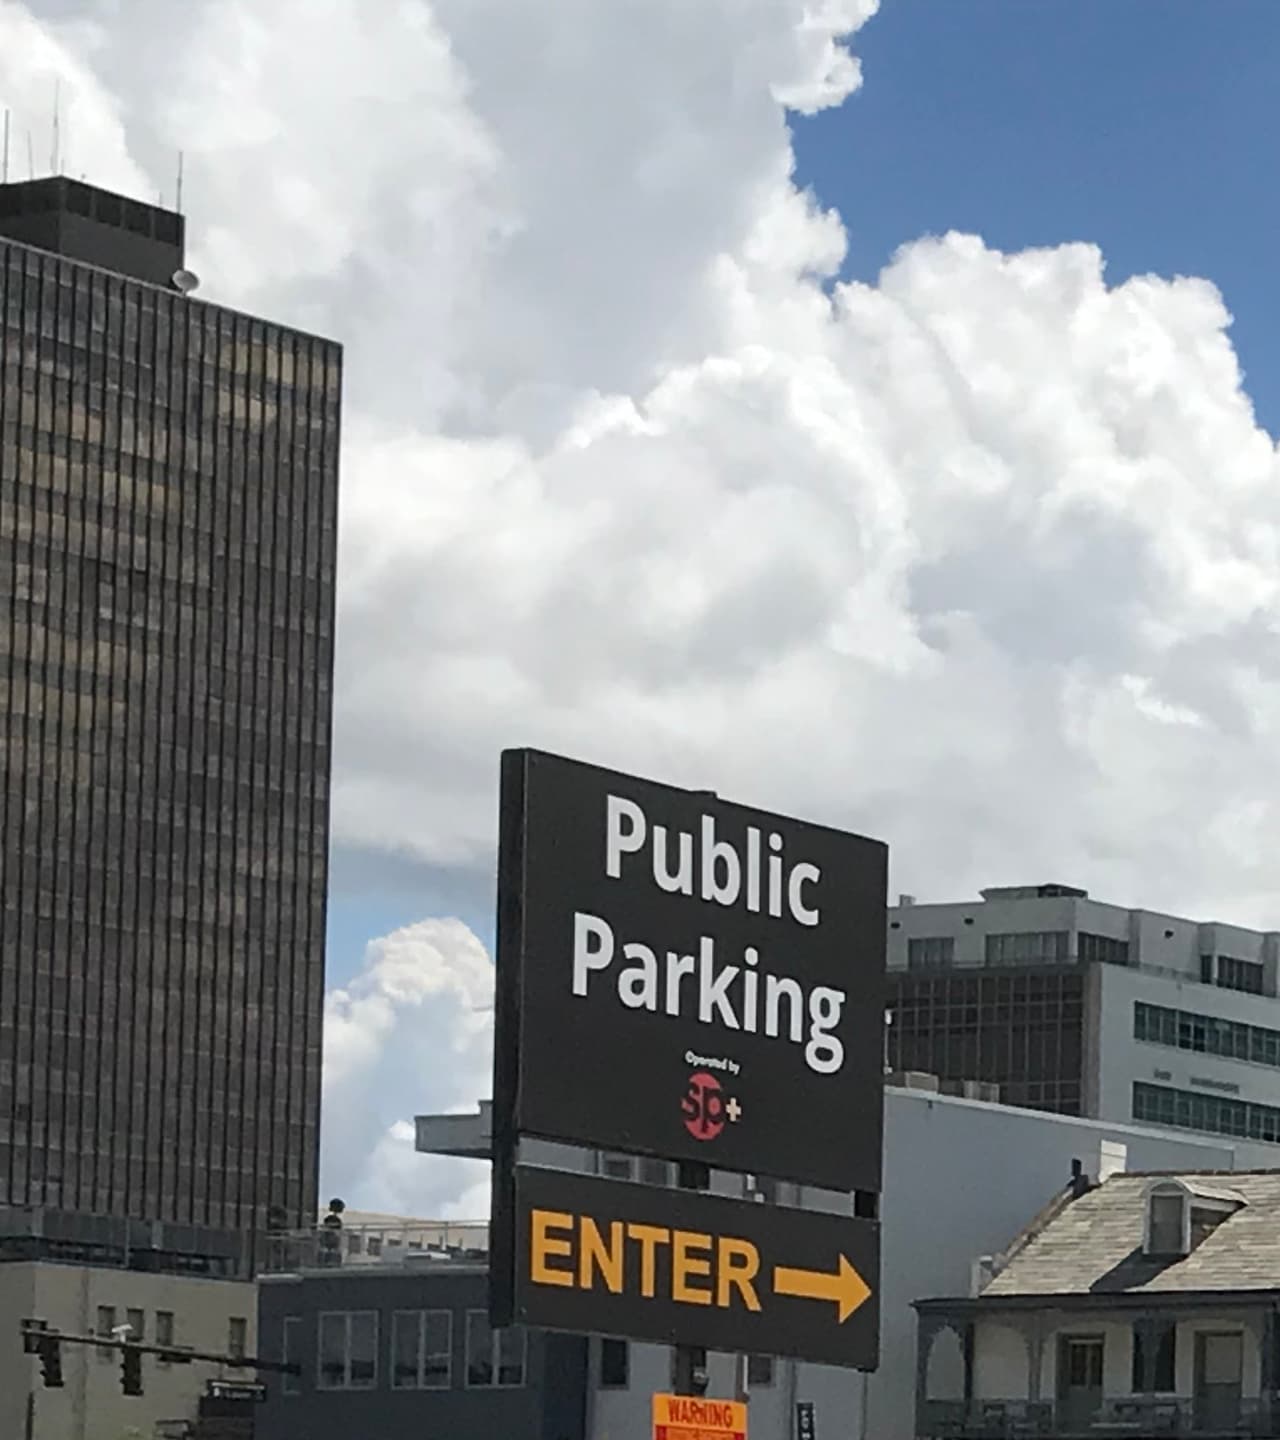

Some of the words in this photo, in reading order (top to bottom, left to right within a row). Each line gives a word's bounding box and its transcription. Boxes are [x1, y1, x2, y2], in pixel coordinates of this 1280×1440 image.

[606, 794, 820, 926] Public
[573, 911, 846, 1074] Parking
[728, 1060, 740, 1075] by
[531, 1209, 762, 1312] ENTER
[668, 1399, 733, 1429] WARNING
